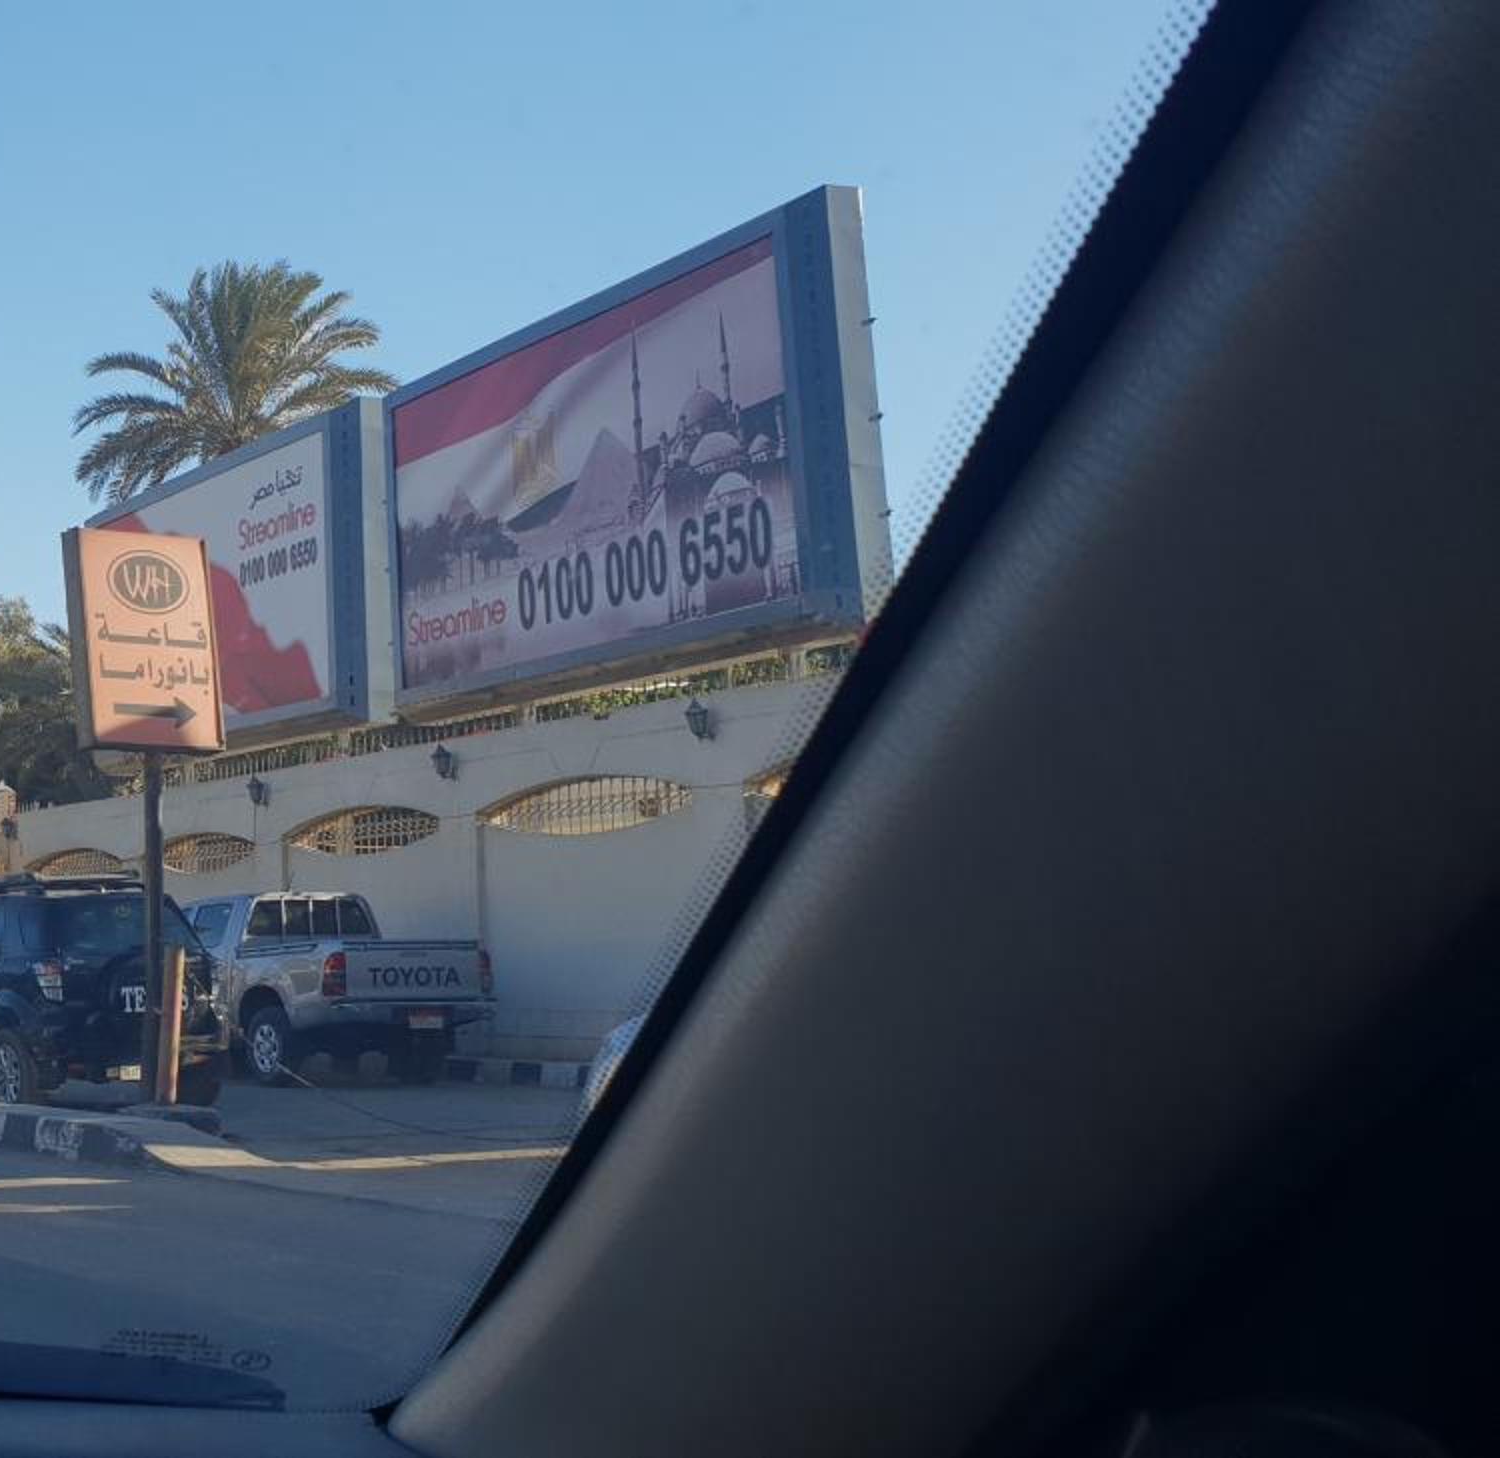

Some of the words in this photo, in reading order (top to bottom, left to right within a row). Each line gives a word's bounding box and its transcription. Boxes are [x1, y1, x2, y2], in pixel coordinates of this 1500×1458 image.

[248, 482, 275, 510] مصر
[238, 502, 317, 551] Streamline
[240, 555, 266, 588] 0100
[267, 547, 288, 579] 000
[290, 537, 318, 571] 6550
[408, 598, 507, 647] Streamline
[518, 551, 593, 631] 0100
[605, 528, 667, 607] 000
[679, 497, 772, 587] 6550
[95, 613, 207, 650] قاعة
[99, 653, 209, 696] بانوراما
[368, 966, 462, 988] TOYOTA
